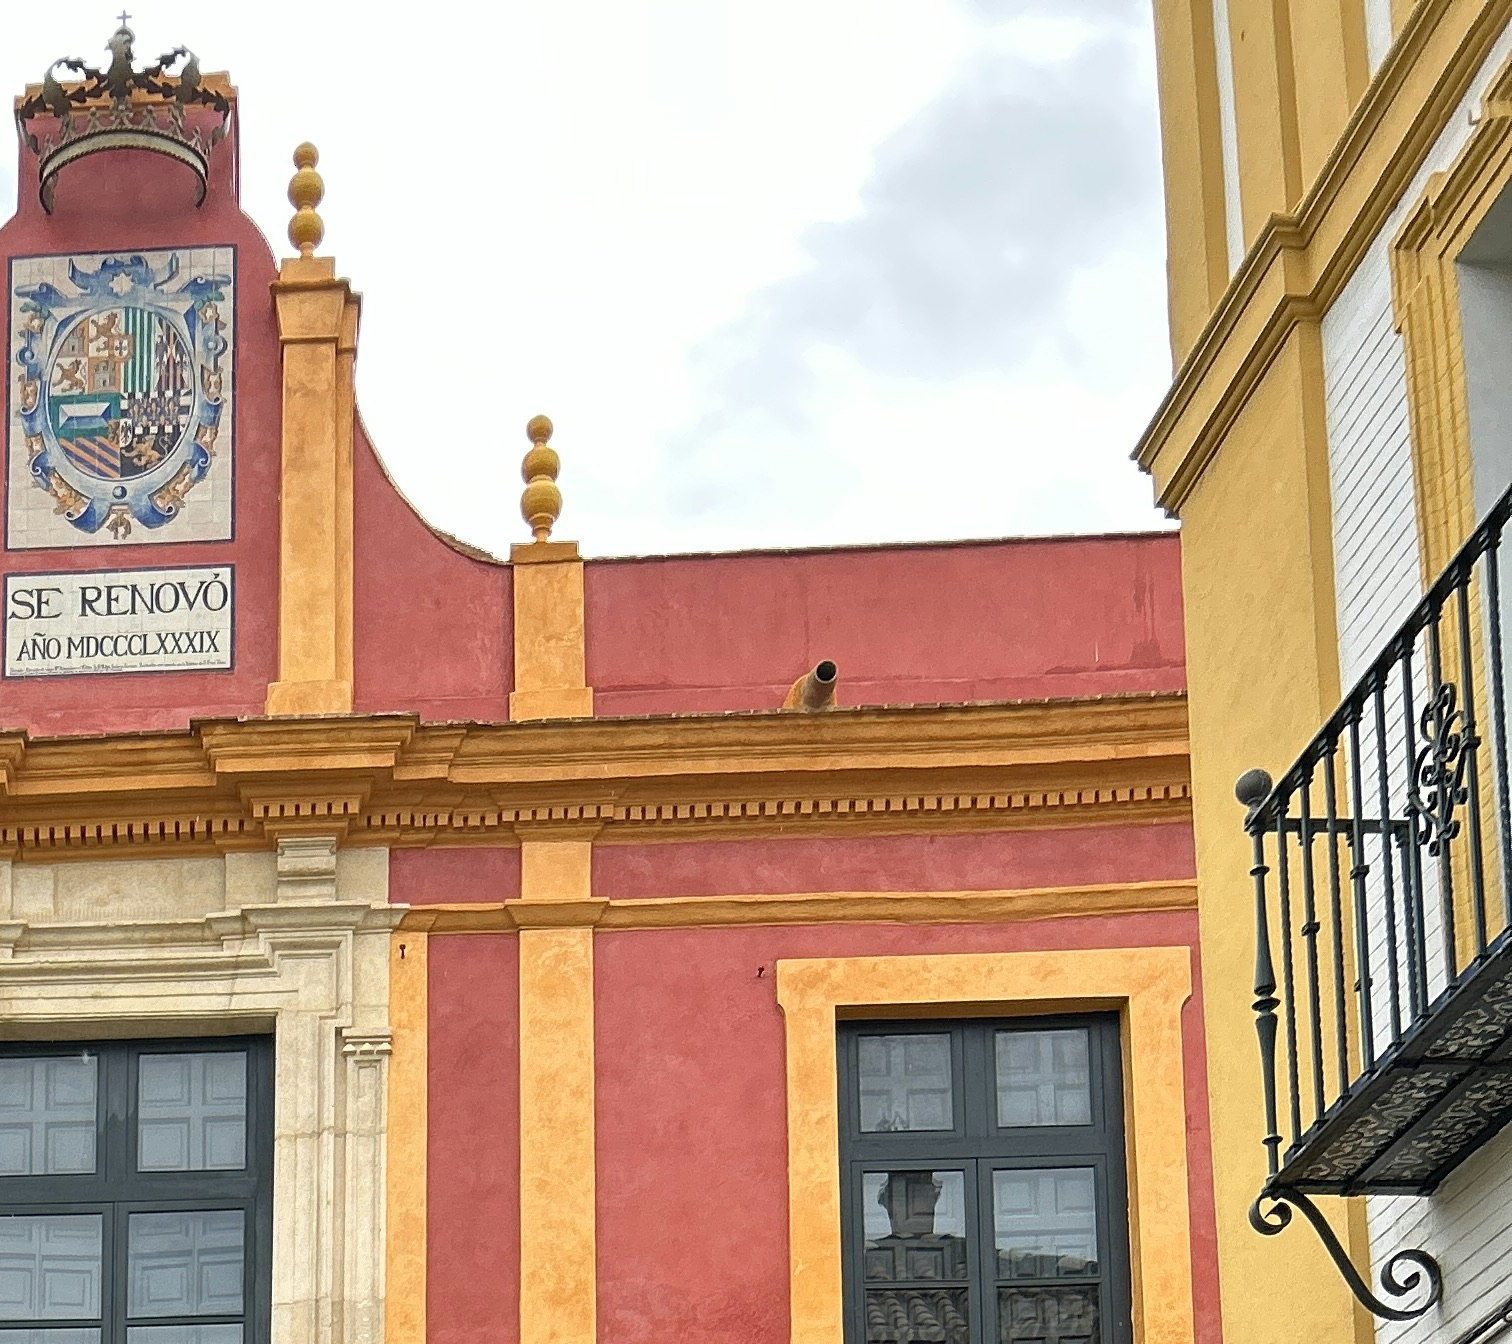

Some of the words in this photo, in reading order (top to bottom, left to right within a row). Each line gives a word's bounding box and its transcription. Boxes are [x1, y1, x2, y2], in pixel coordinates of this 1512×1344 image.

[8, 587, 63, 620] SE
[78, 573, 229, 617] RENOVÓ
[16, 632, 62, 661] AÑO
[66, 630, 221, 659] MDCCCLXXXIX
